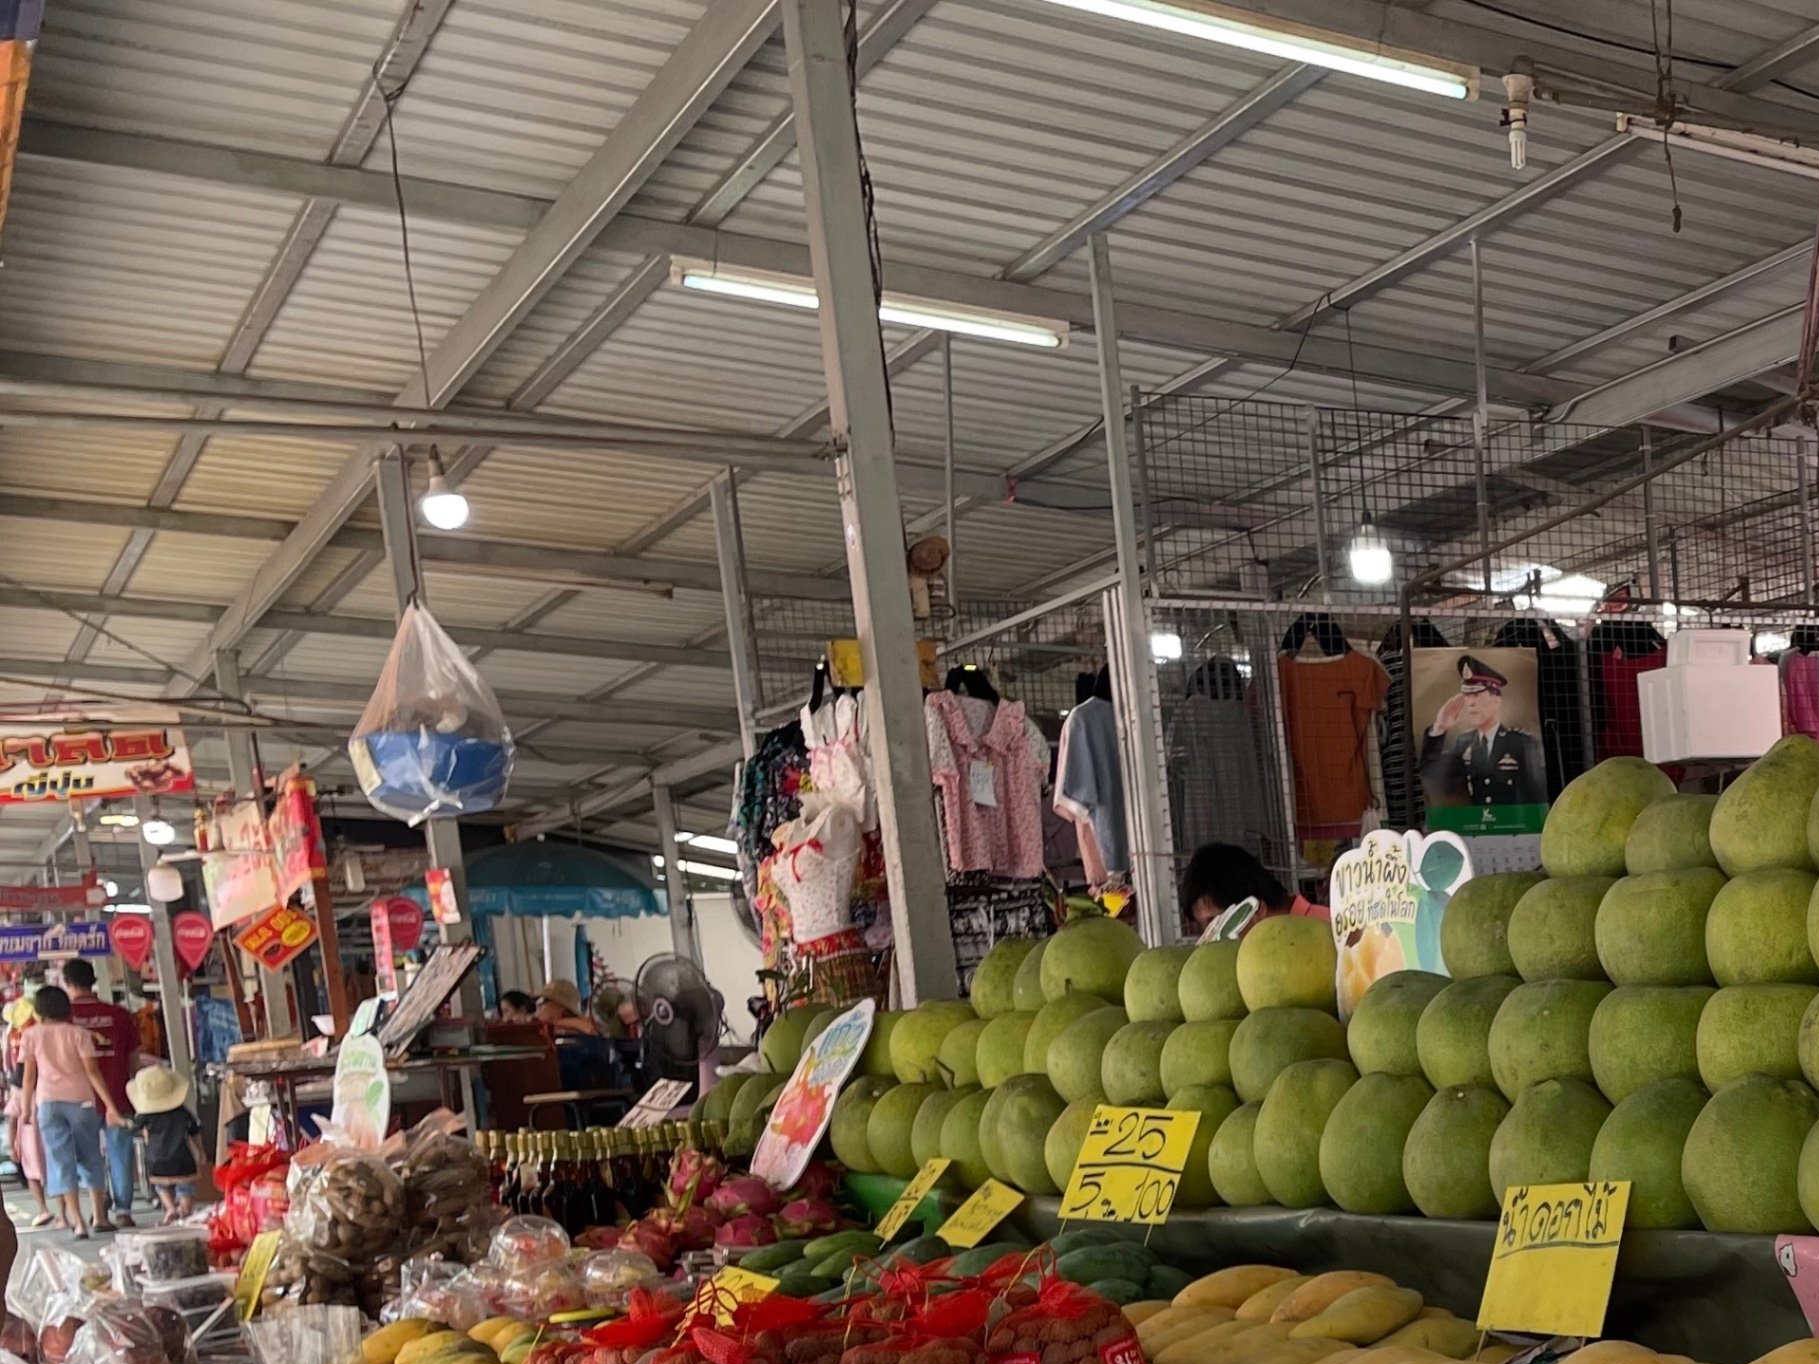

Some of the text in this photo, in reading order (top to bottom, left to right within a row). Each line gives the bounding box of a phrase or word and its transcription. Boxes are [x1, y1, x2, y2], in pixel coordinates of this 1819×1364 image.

[1336, 840, 1408, 900] ขาวน้ำผึ้ง
[1103, 1112, 1174, 1160] 25
[1070, 1171, 1106, 1212] 5
[1131, 1169, 1176, 1220] 100
[1503, 1182, 1617, 1246] น้ำดอกไม้
